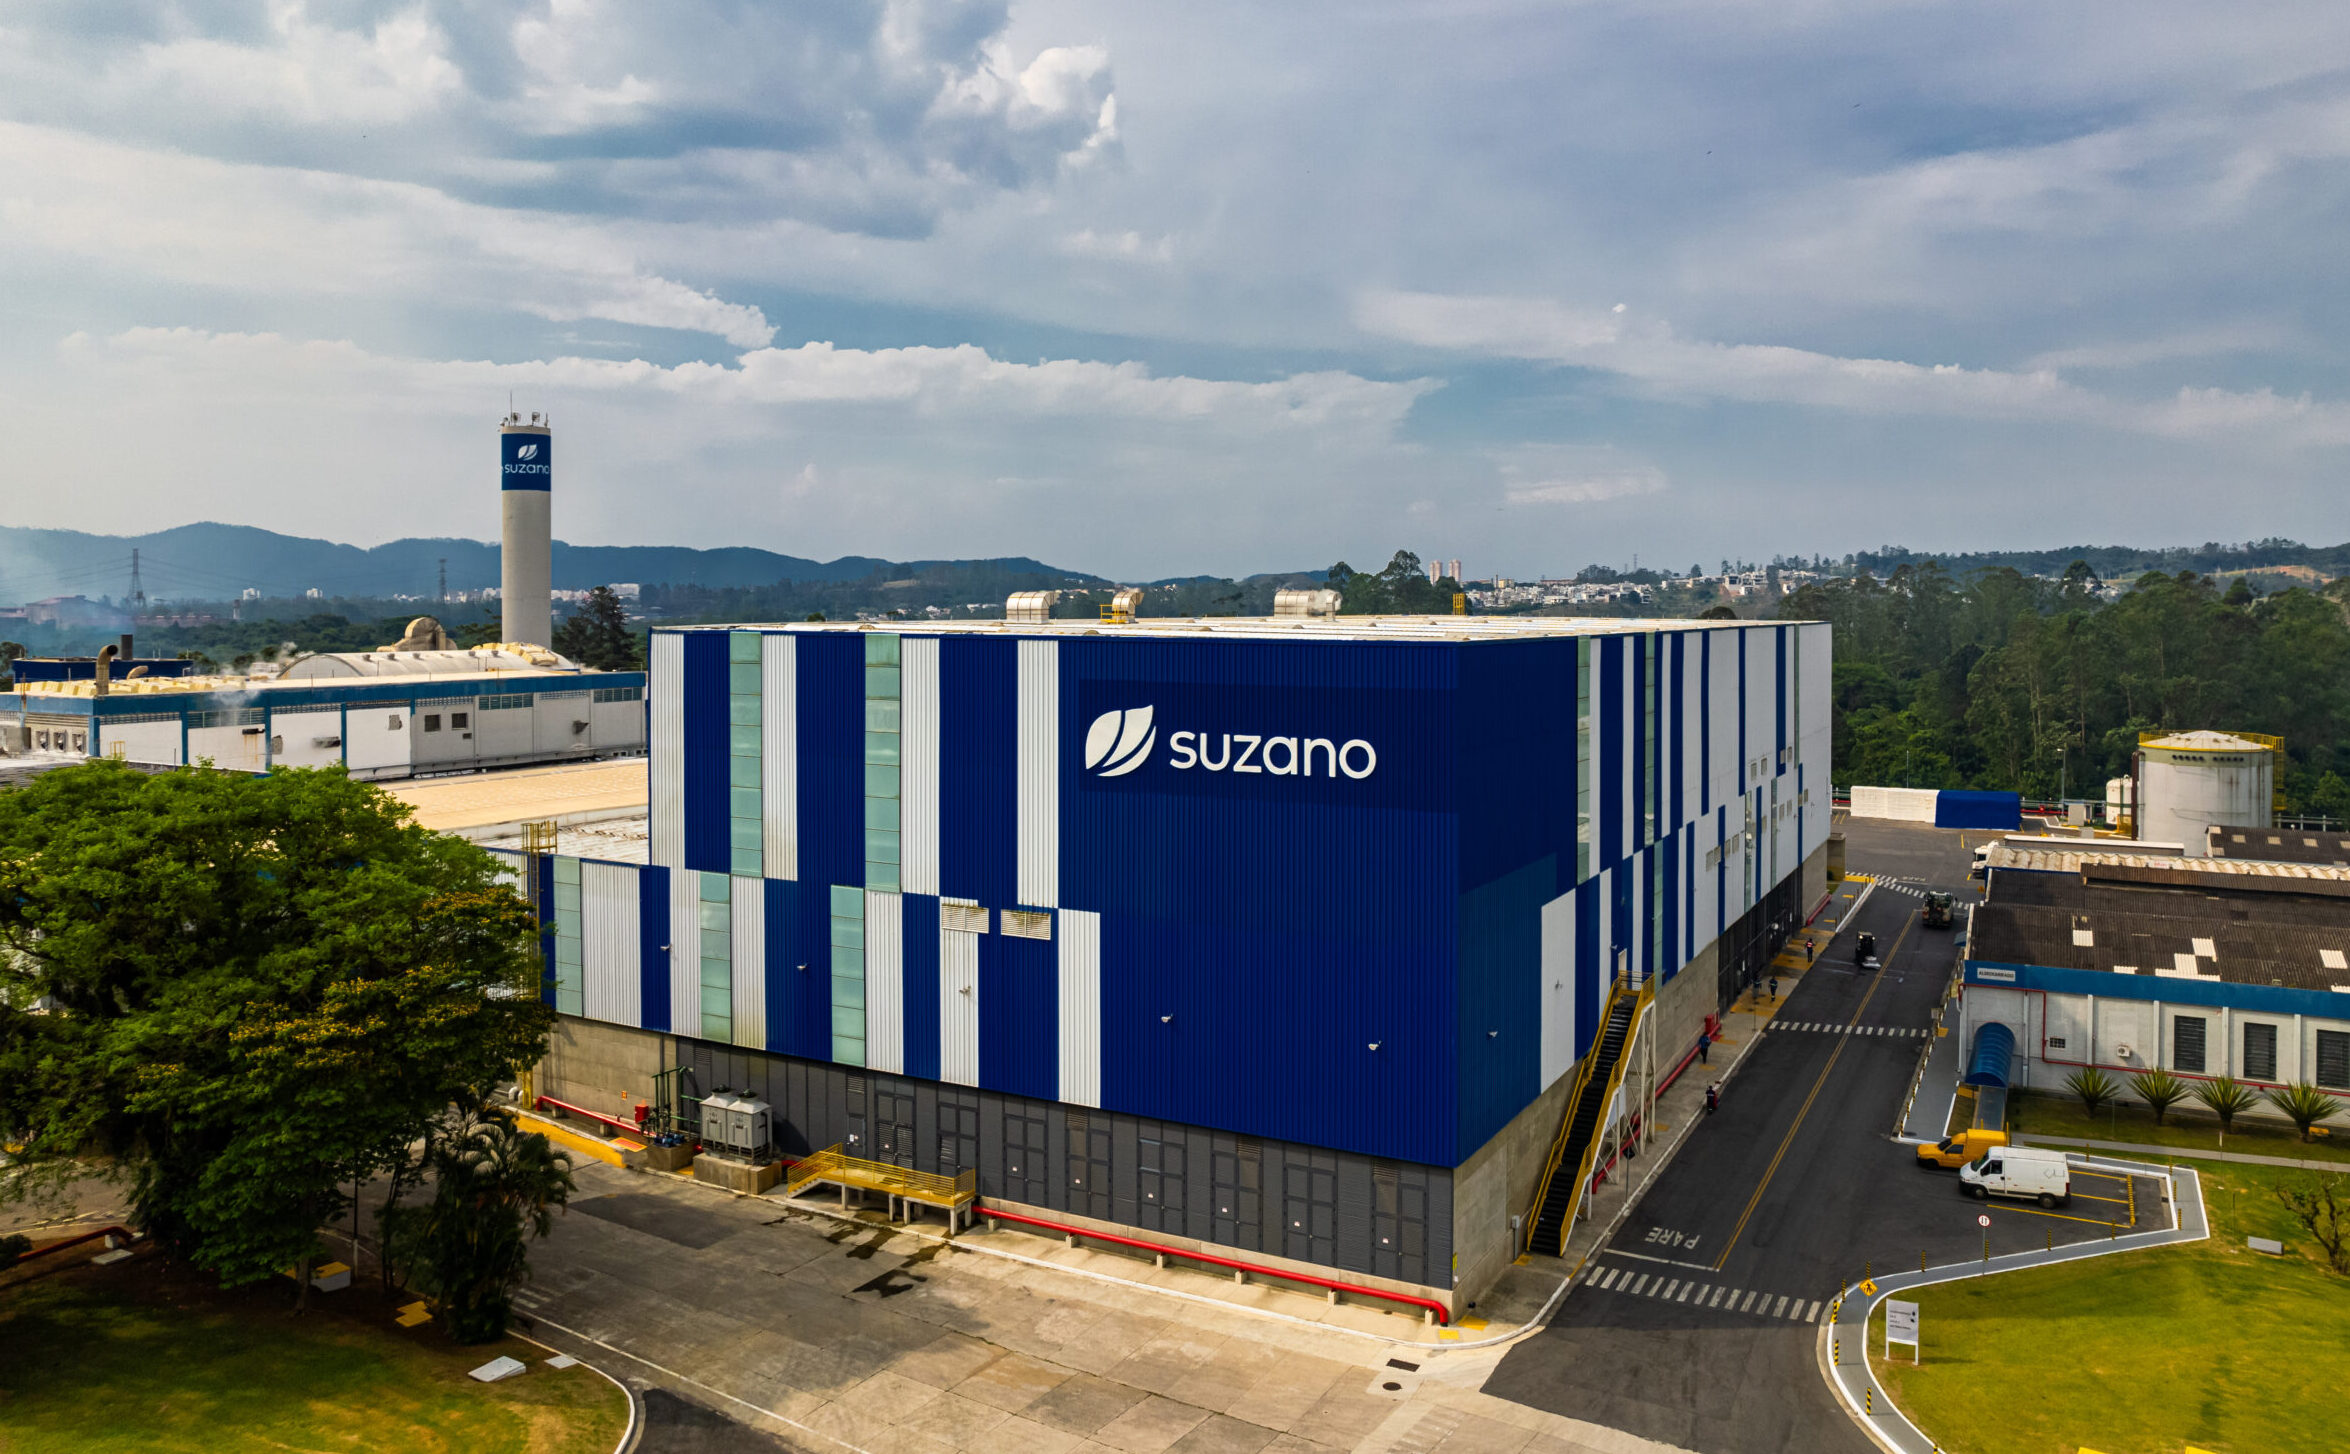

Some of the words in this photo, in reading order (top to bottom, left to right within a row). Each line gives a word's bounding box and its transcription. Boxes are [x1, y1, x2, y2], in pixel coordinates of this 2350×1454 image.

[504, 463, 550, 475] suzano
[1169, 730, 1377, 780] suzano
[1644, 1226, 1701, 1250] PARE
